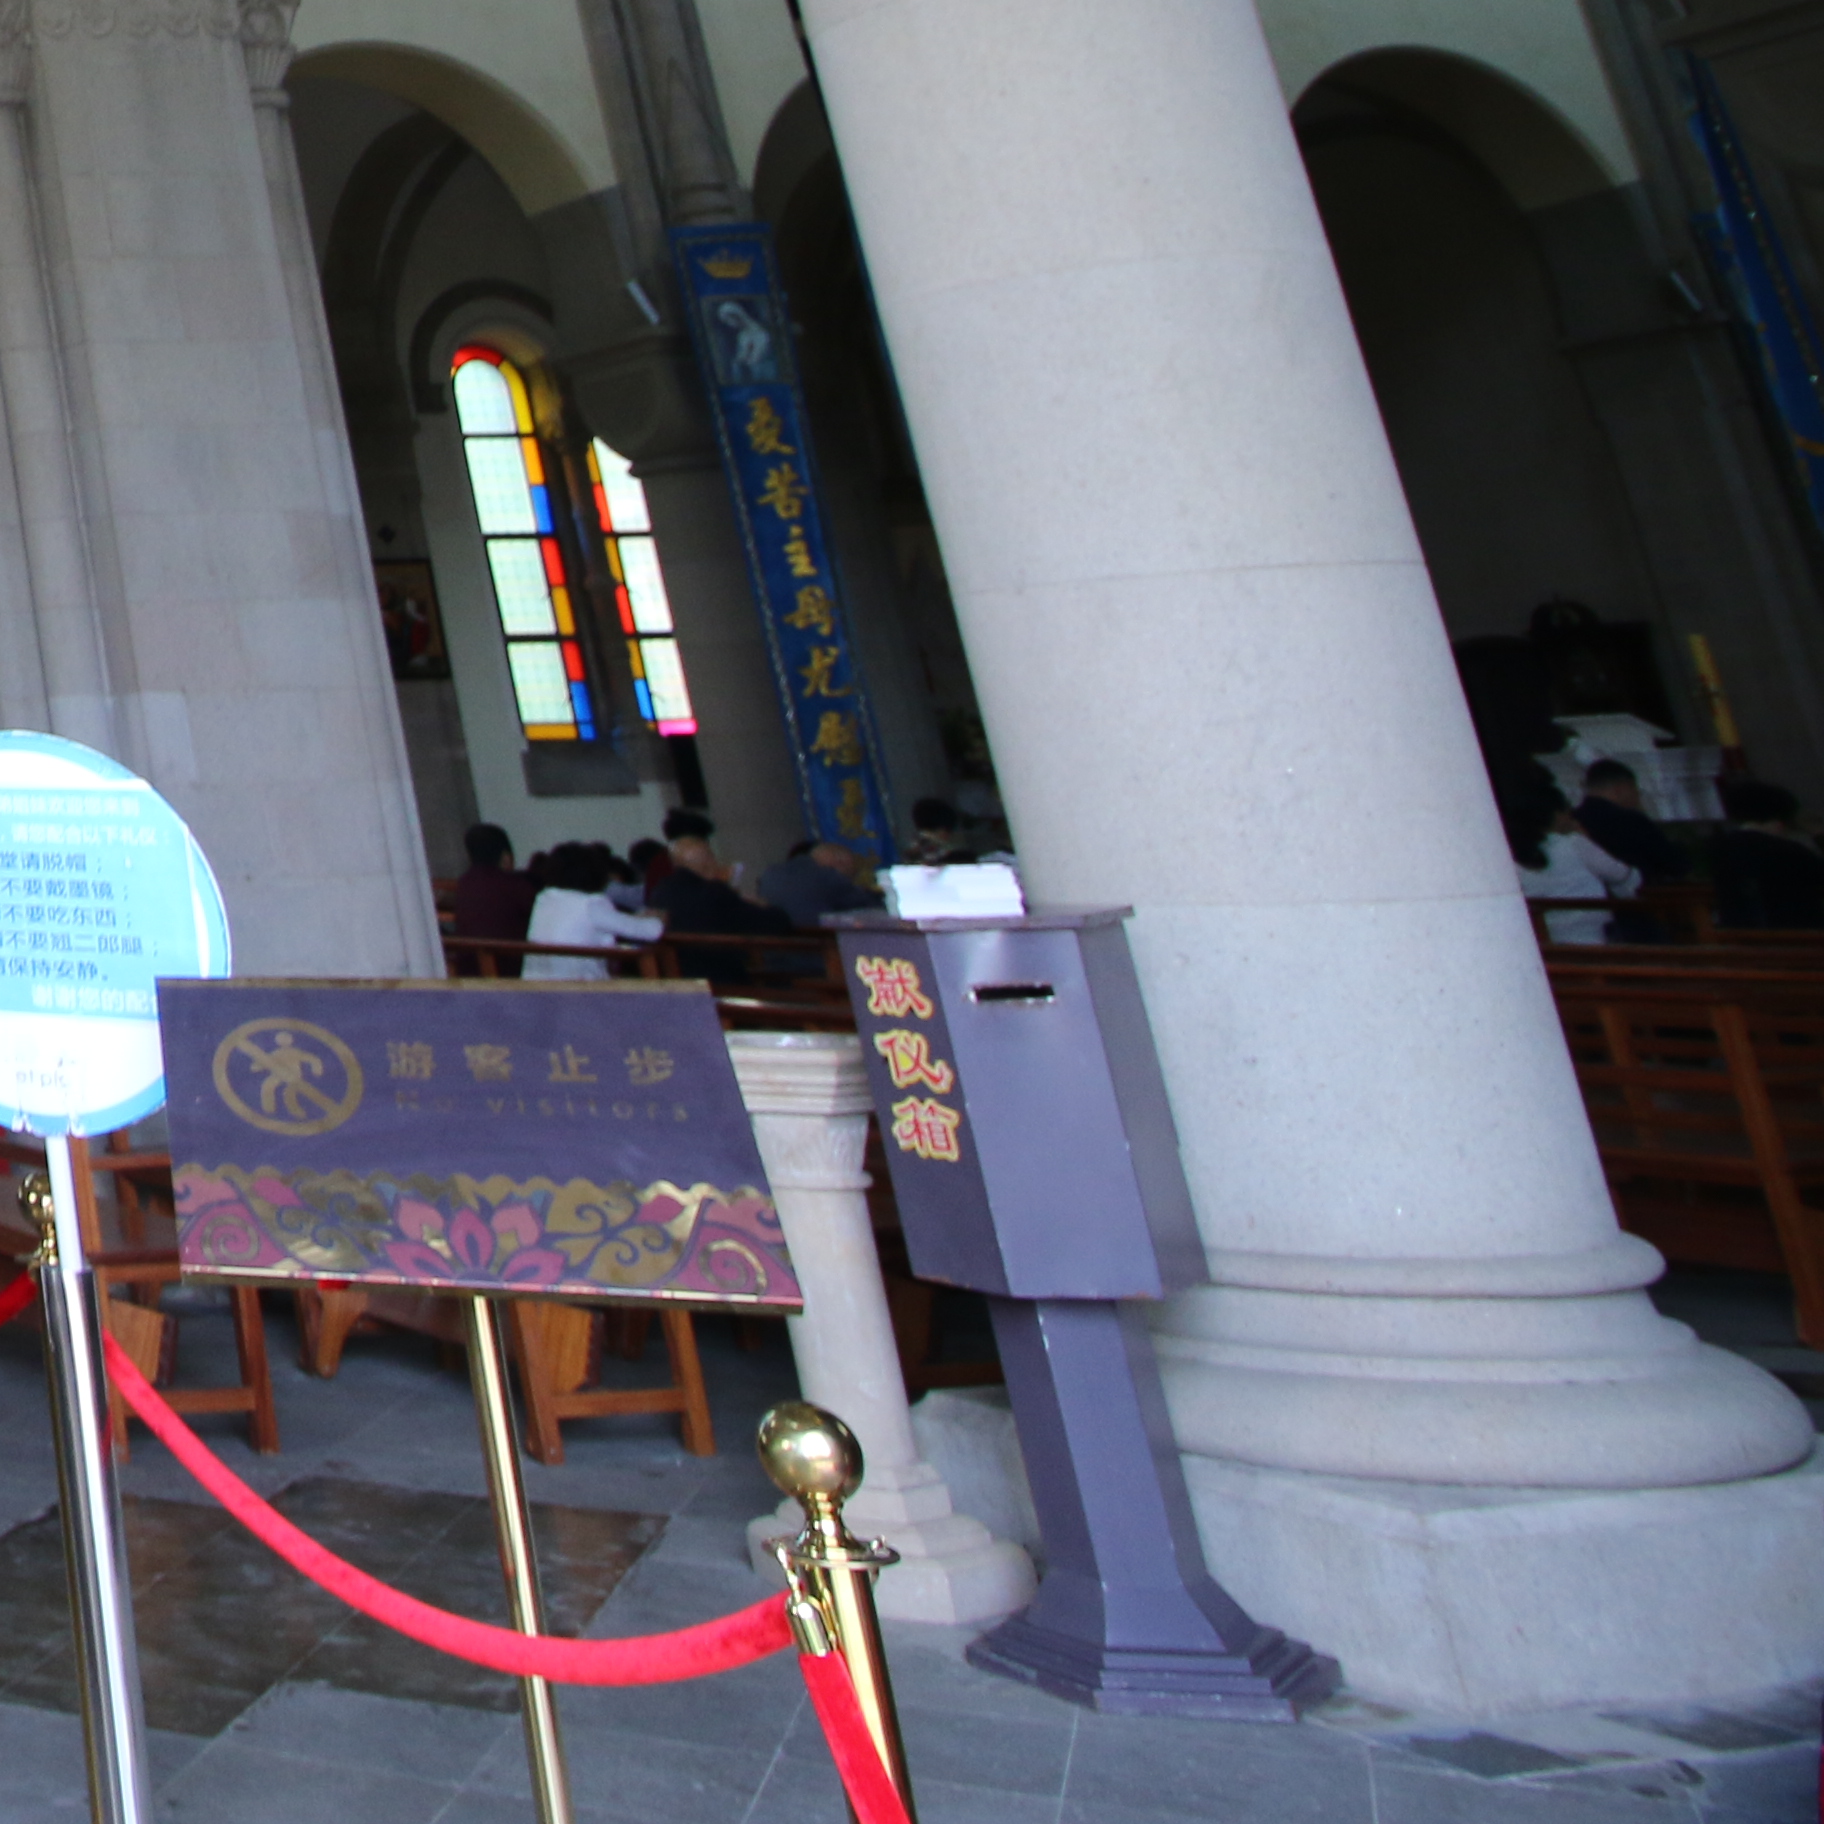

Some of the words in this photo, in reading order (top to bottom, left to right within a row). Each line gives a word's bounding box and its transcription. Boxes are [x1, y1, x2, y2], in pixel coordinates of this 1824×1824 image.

[31, 983, 158, 1015] 谢谢您的配
[385, 1041, 675, 1086] 游客止步
[855, 955, 961, 1163] 献仪箱
[486, 1093, 689, 1122] visitors
